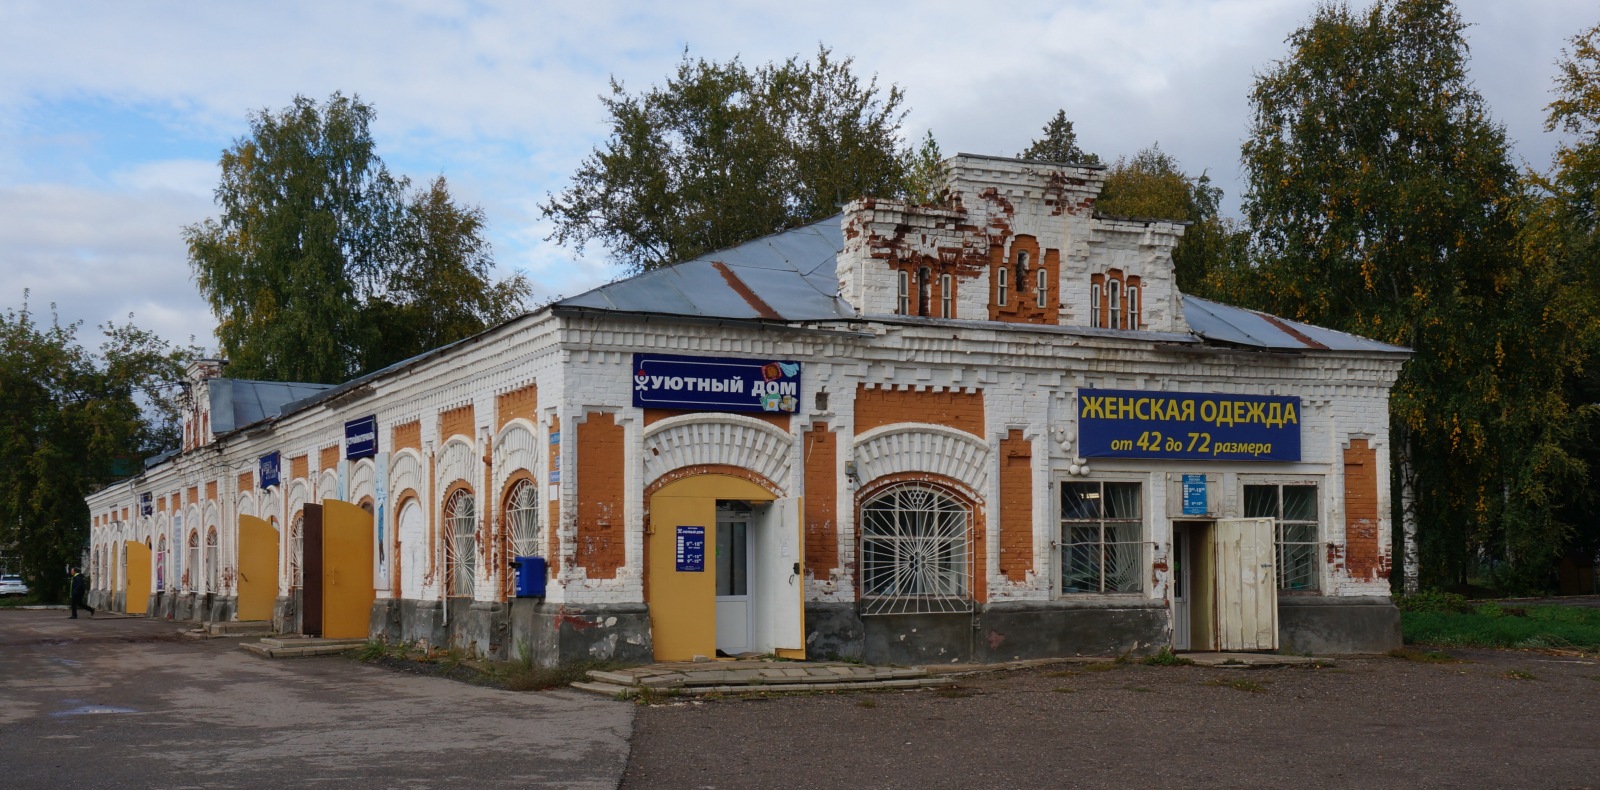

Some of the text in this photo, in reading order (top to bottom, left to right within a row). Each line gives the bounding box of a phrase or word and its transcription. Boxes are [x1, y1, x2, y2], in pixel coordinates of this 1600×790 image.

[651, 375, 797, 396] УЮТНЫЙ ДОМ
[1081, 396, 1298, 428] ЖЕНСКАЯ ОДЕЖДА
[1110, 431, 1272, 456] от 42 до 72 размера
